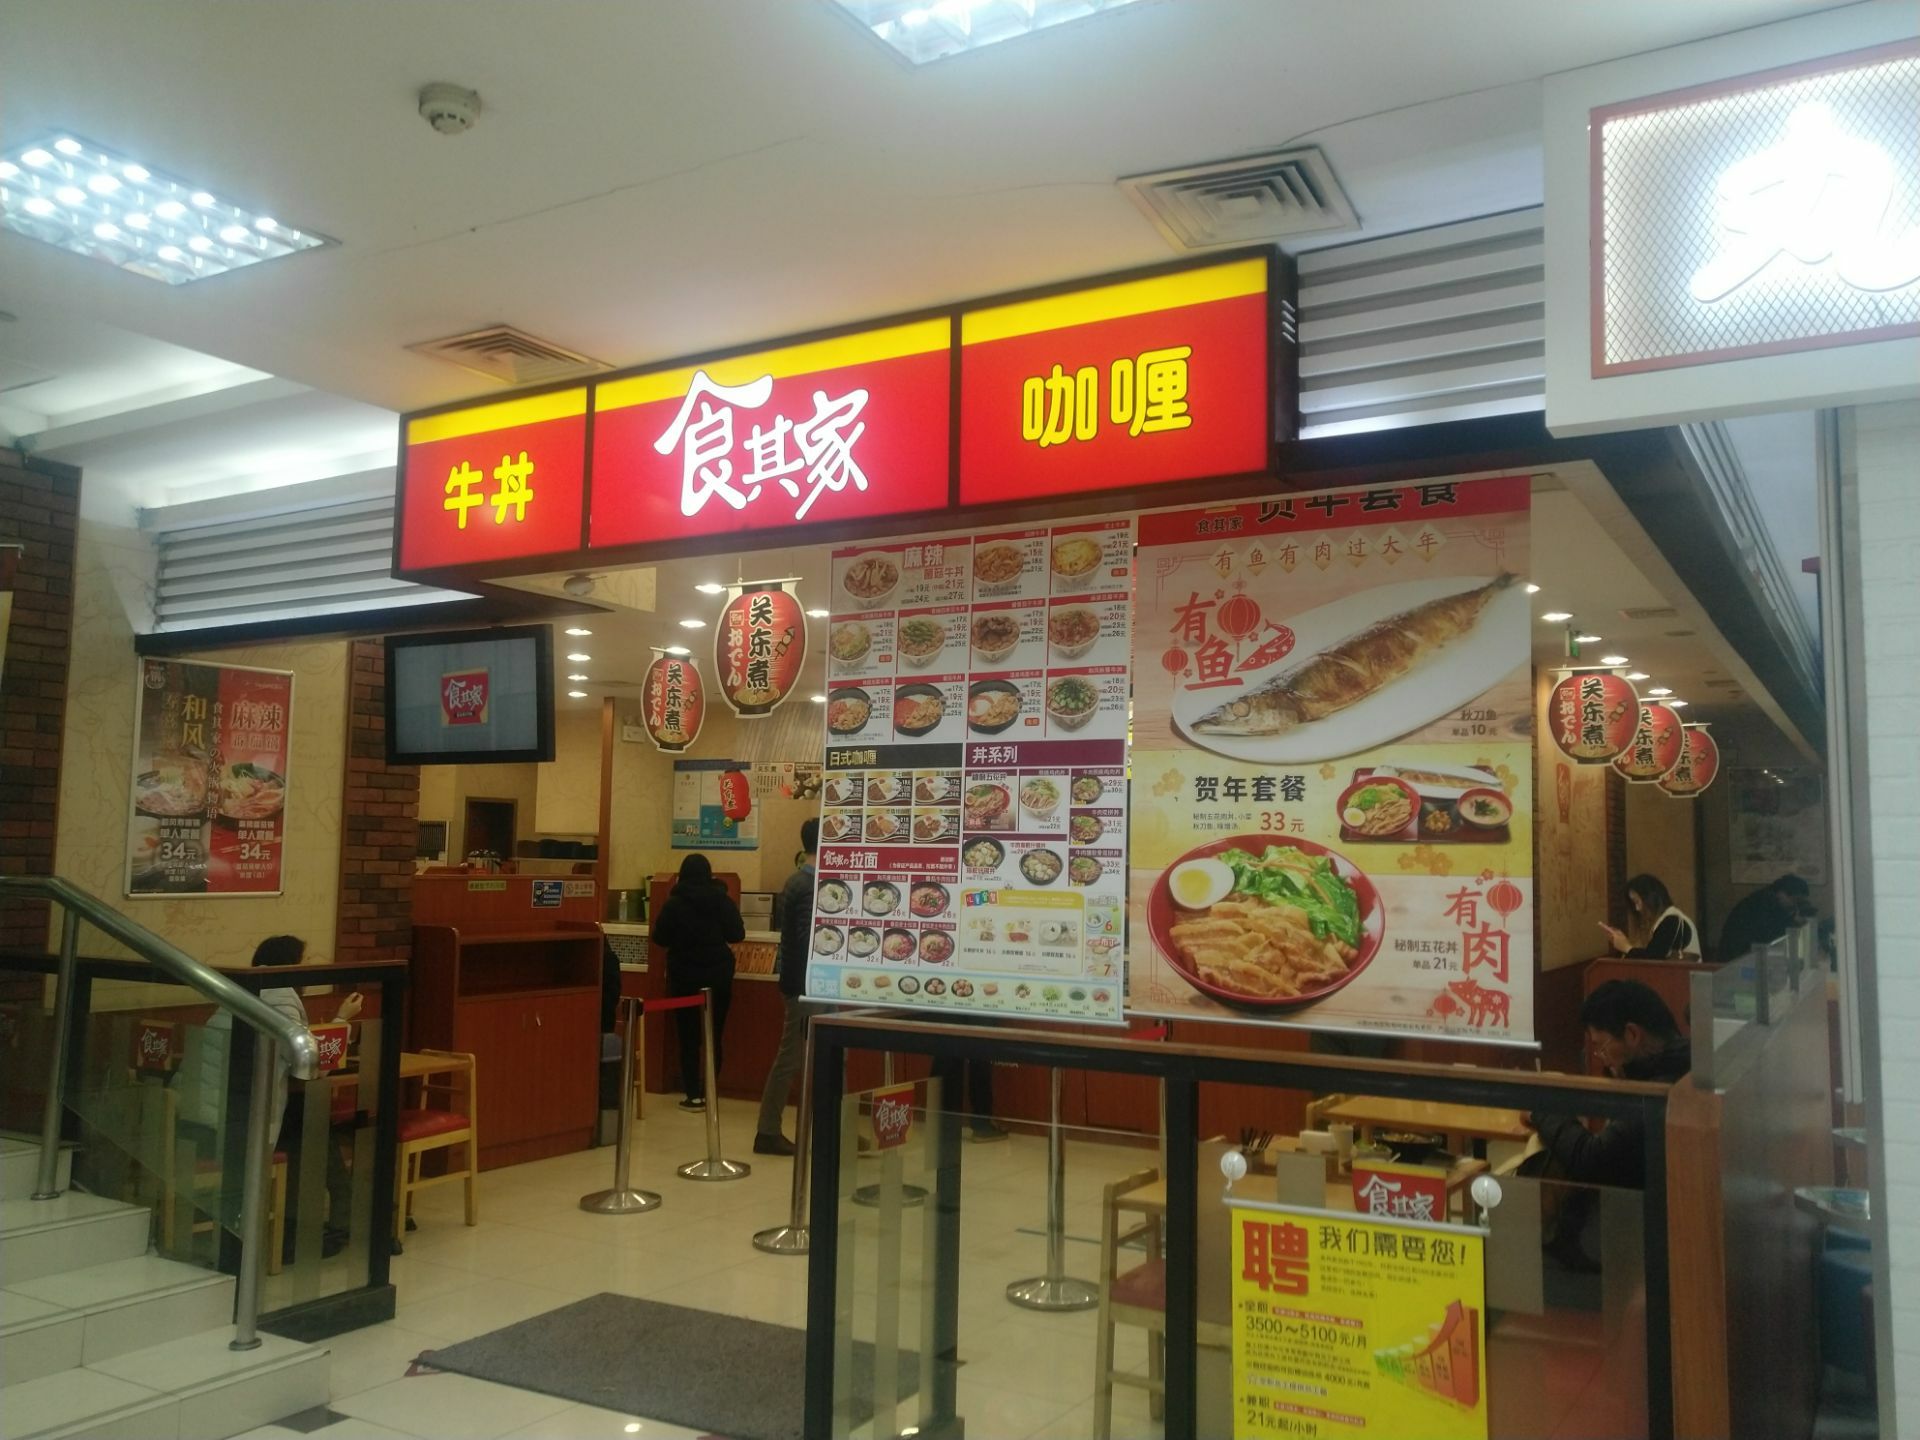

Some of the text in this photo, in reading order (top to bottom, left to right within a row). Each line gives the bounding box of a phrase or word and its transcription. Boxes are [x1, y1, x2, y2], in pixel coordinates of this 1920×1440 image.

[1021, 346, 1192, 449] 咖喱
[653, 370, 870, 521] 食其家
[444, 450, 535, 530] 牛丼
[1112, 539, 1129, 549] 21元
[1213, 530, 1439, 573] 有鱼有肉过大年
[726, 627, 744, 687] おでん
[747, 594, 773, 689] 关东煮
[1170, 590, 1245, 692] 有鱼
[181, 693, 206, 750] 和风
[231, 703, 283, 731] 麻辣
[664, 663, 682, 731] 关东煮
[1461, 708, 1497, 722] 秋刀鱼
[1581, 677, 1605, 745] 关东煮
[972, 745, 1018, 764] 丼系列
[1195, 774, 1306, 803] 贺年套餐
[161, 841, 196, 860] 34元
[239, 842, 272, 860] 34元
[1394, 938, 1458, 955] 秘制五花丼
[1443, 885, 1512, 984] 有肉
[1242, 1220, 1310, 1297] 聘
